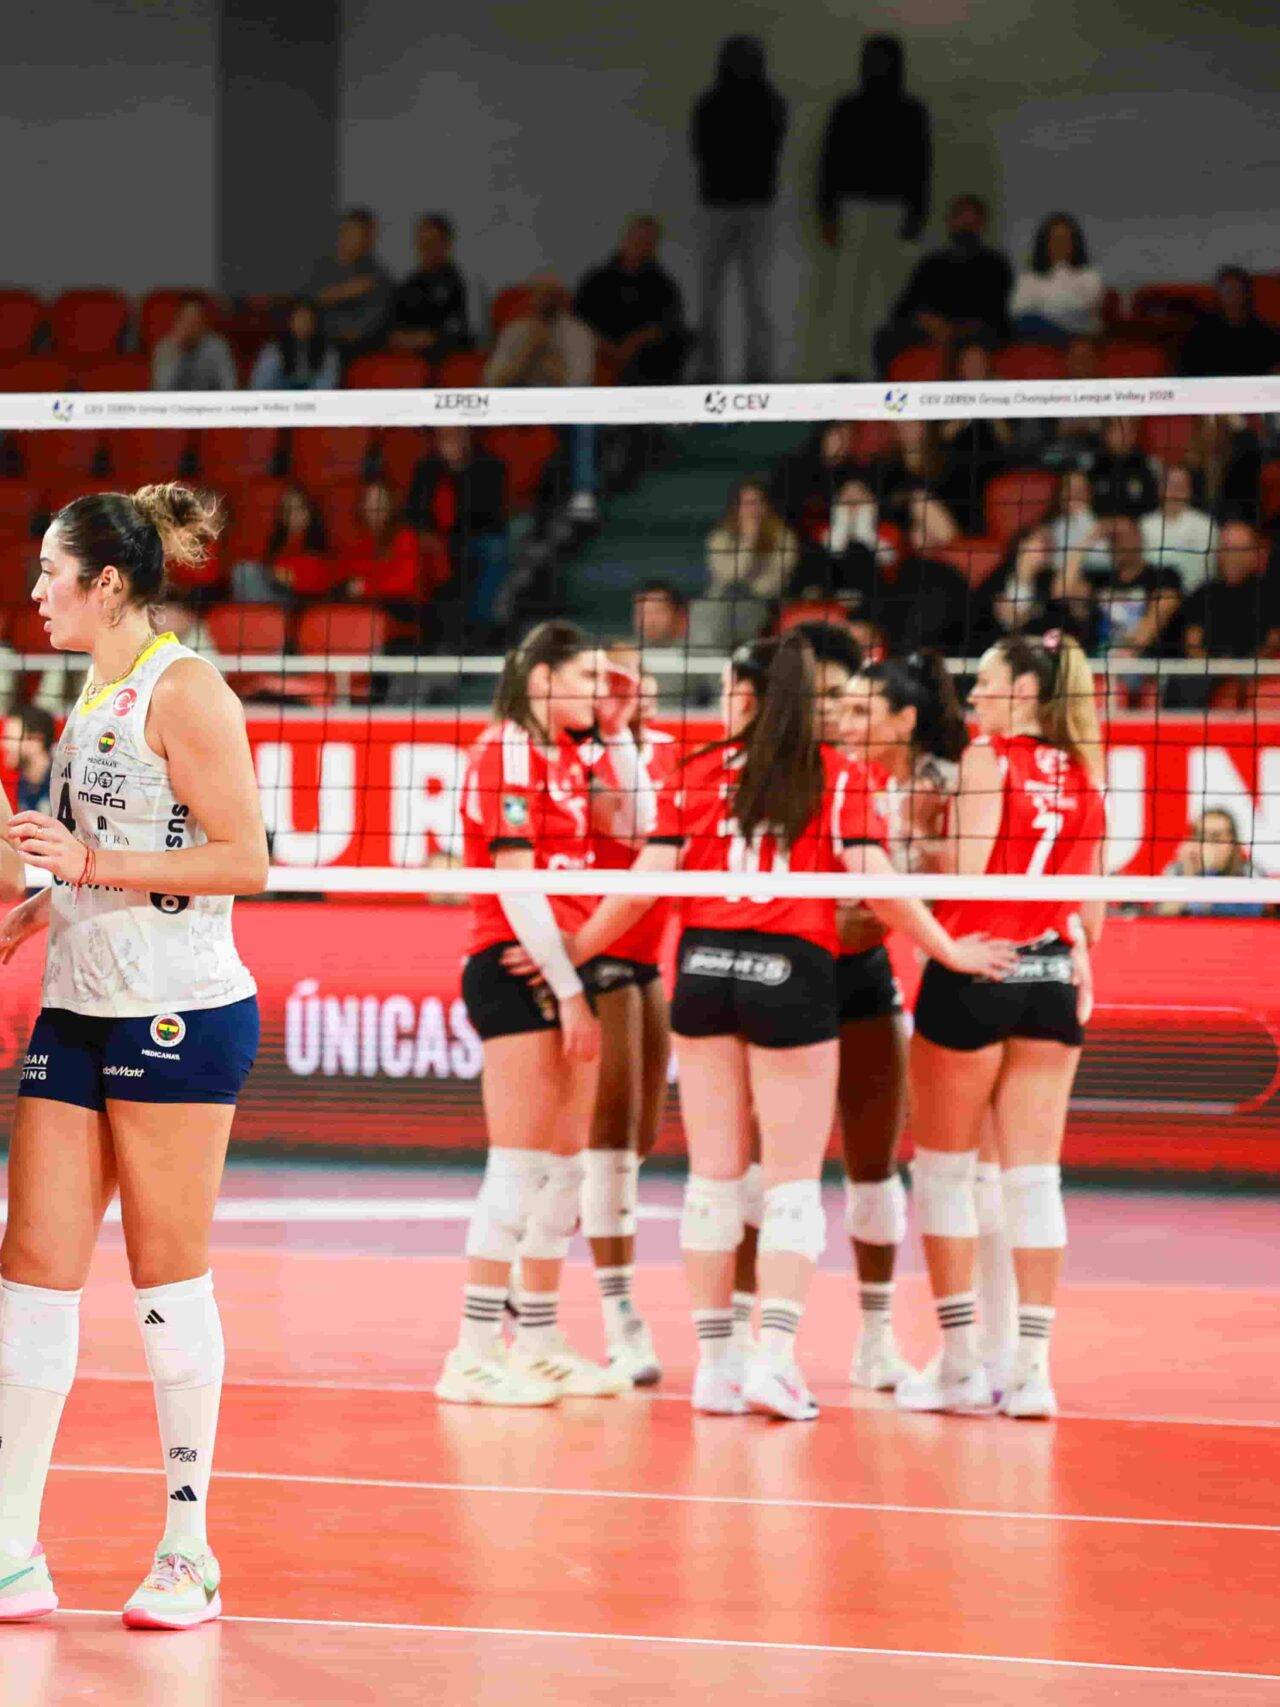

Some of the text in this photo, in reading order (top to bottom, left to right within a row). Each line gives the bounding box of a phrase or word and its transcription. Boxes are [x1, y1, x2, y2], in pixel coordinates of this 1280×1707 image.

[434, 393, 489, 409] ZEREN
[733, 394, 770, 411] CEV
[83, 765, 126, 794] 1907
[78, 791, 126, 810] mefa
[1032, 810, 1064, 877] 7
[284, 977, 484, 1080] ÚNICAS
